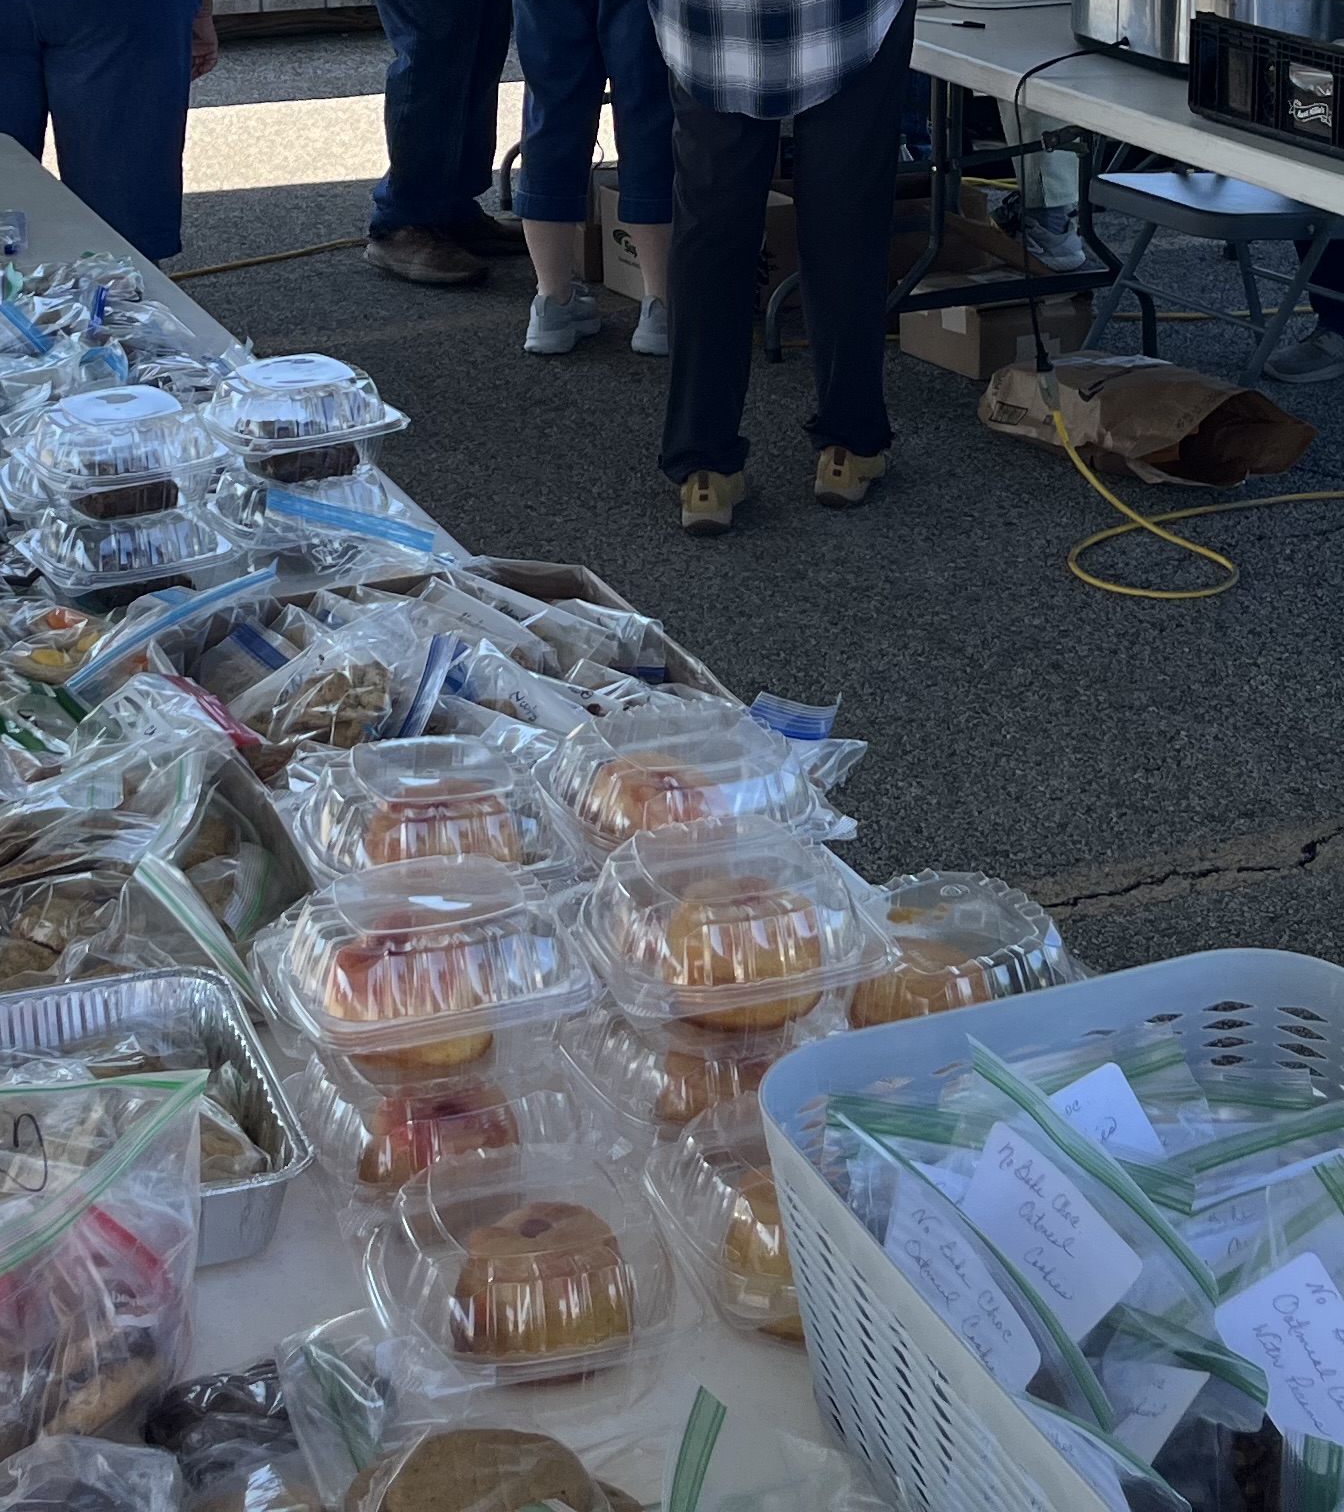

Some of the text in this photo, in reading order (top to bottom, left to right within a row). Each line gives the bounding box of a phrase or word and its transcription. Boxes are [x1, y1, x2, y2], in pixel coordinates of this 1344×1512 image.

[1015, 1159, 1047, 1199] Bake
[911, 1208, 942, 1235] No
[1018, 1200, 1076, 1259] Oatmeal
[905, 1239, 961, 1313] Oatmeal
[1305, 1282, 1338, 1306] No
[1252, 1322, 1285, 1370] With
[1272, 1293, 1337, 1382] Oatmeal
